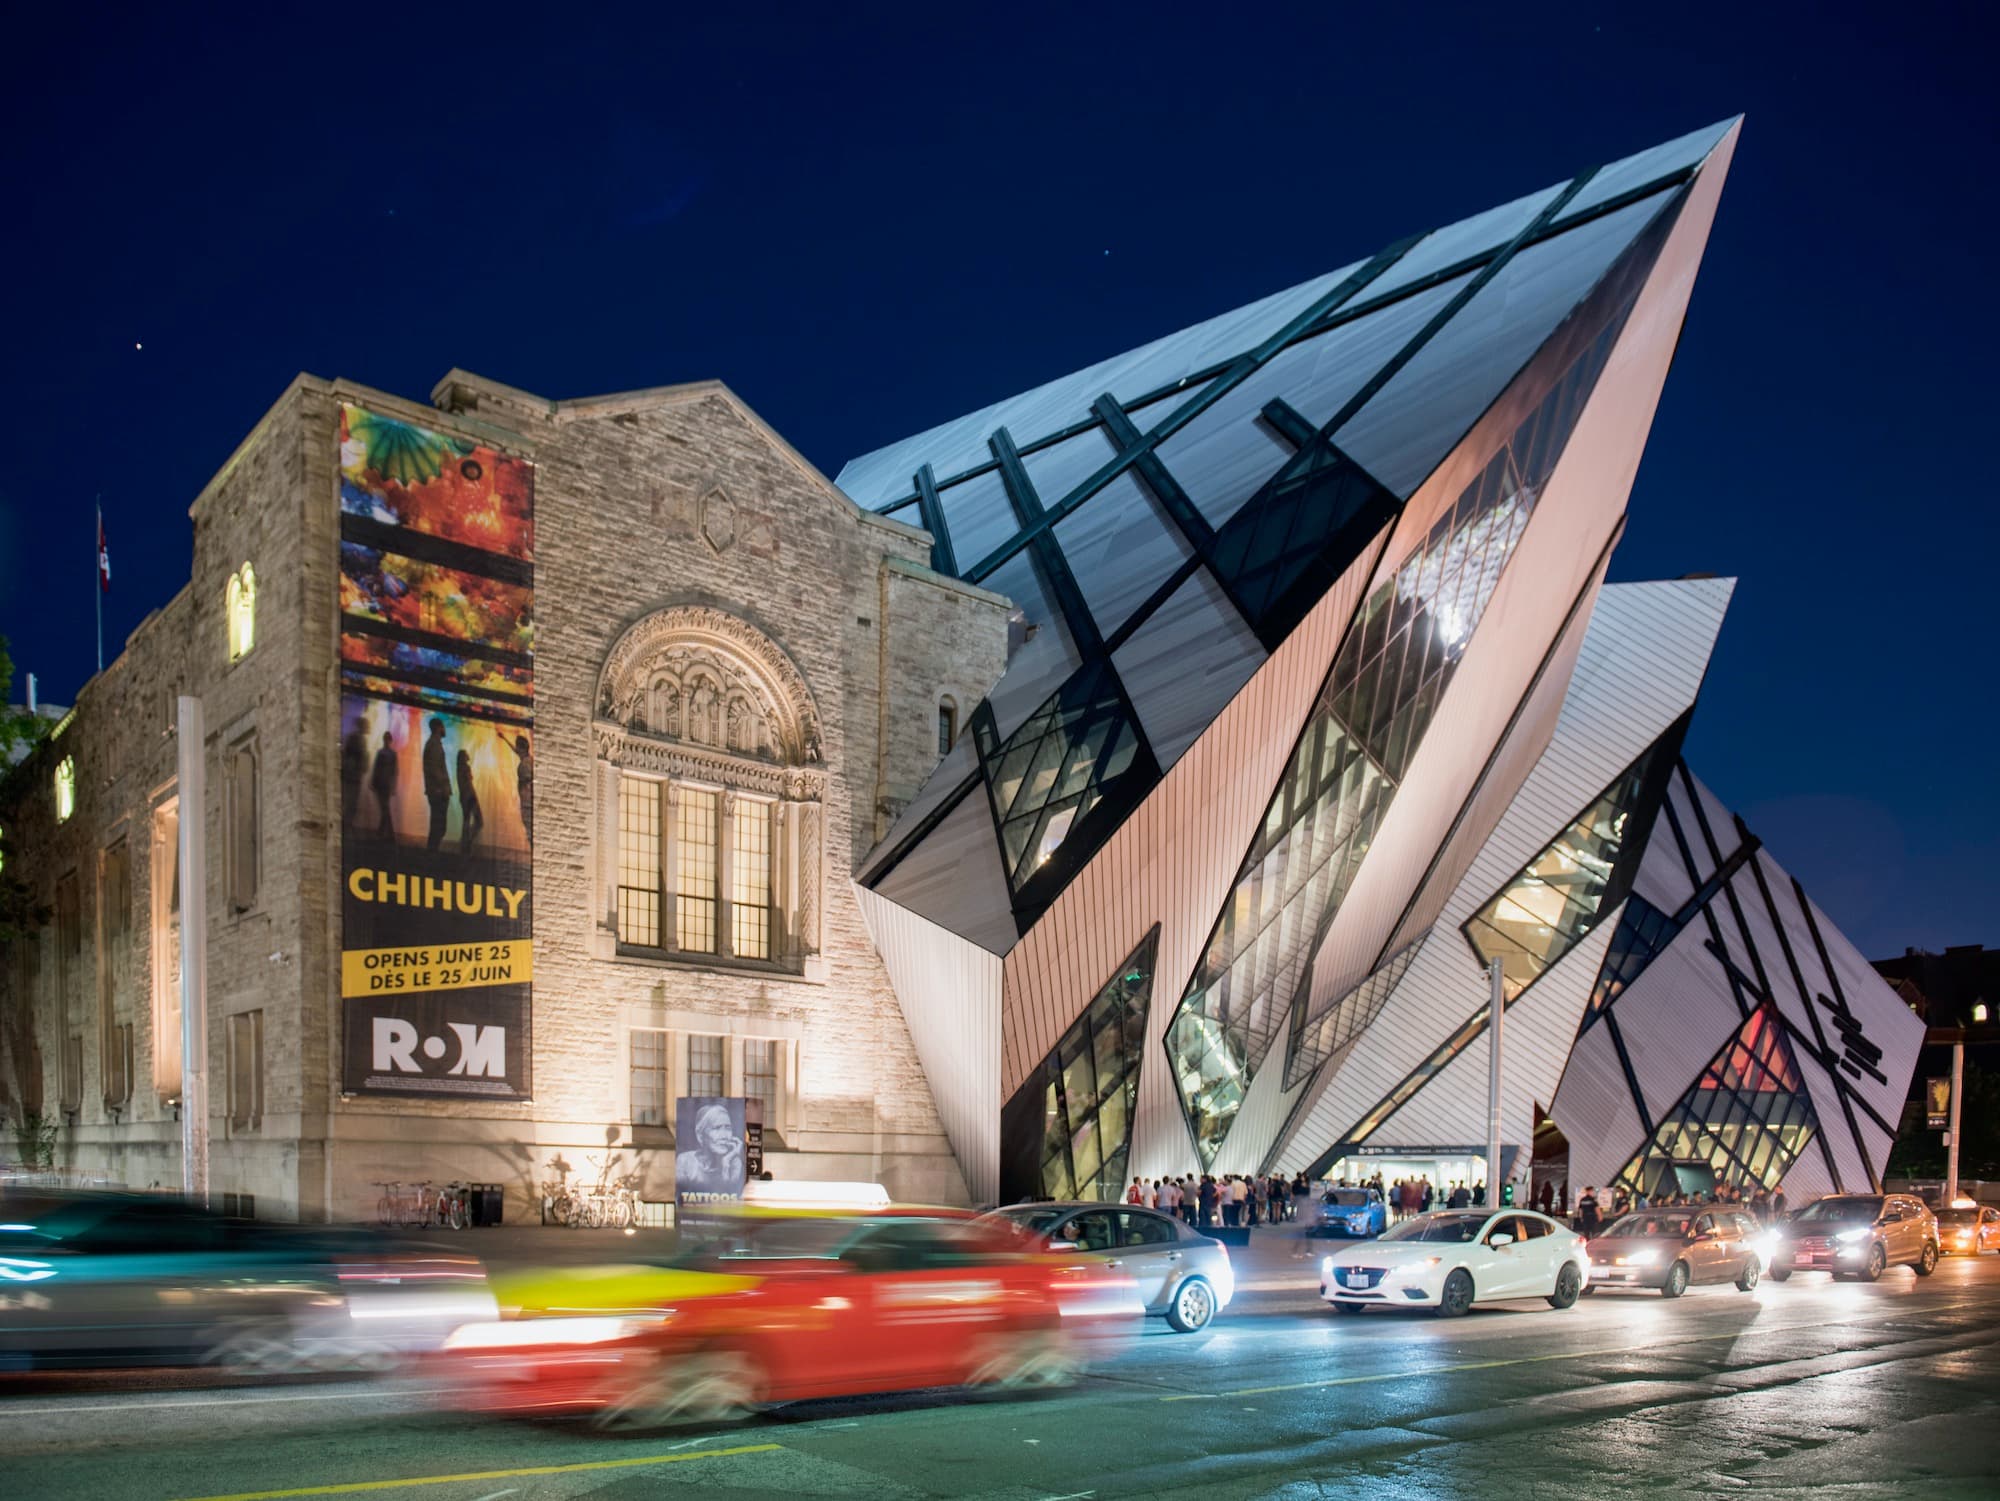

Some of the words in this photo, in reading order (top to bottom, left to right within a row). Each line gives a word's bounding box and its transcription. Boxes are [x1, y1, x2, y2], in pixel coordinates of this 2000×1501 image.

[349, 868, 527, 919] CHIHULY
[364, 951, 429, 969] OPENS
[436, 947, 482, 964] JUNE
[490, 945, 510, 960] 25
[370, 970, 405, 989] DÈS
[413, 971, 431, 986] LE
[440, 969, 461, 984] 25
[470, 965, 511, 982] JUIN
[681, 1191, 737, 1203] TATTOOS
